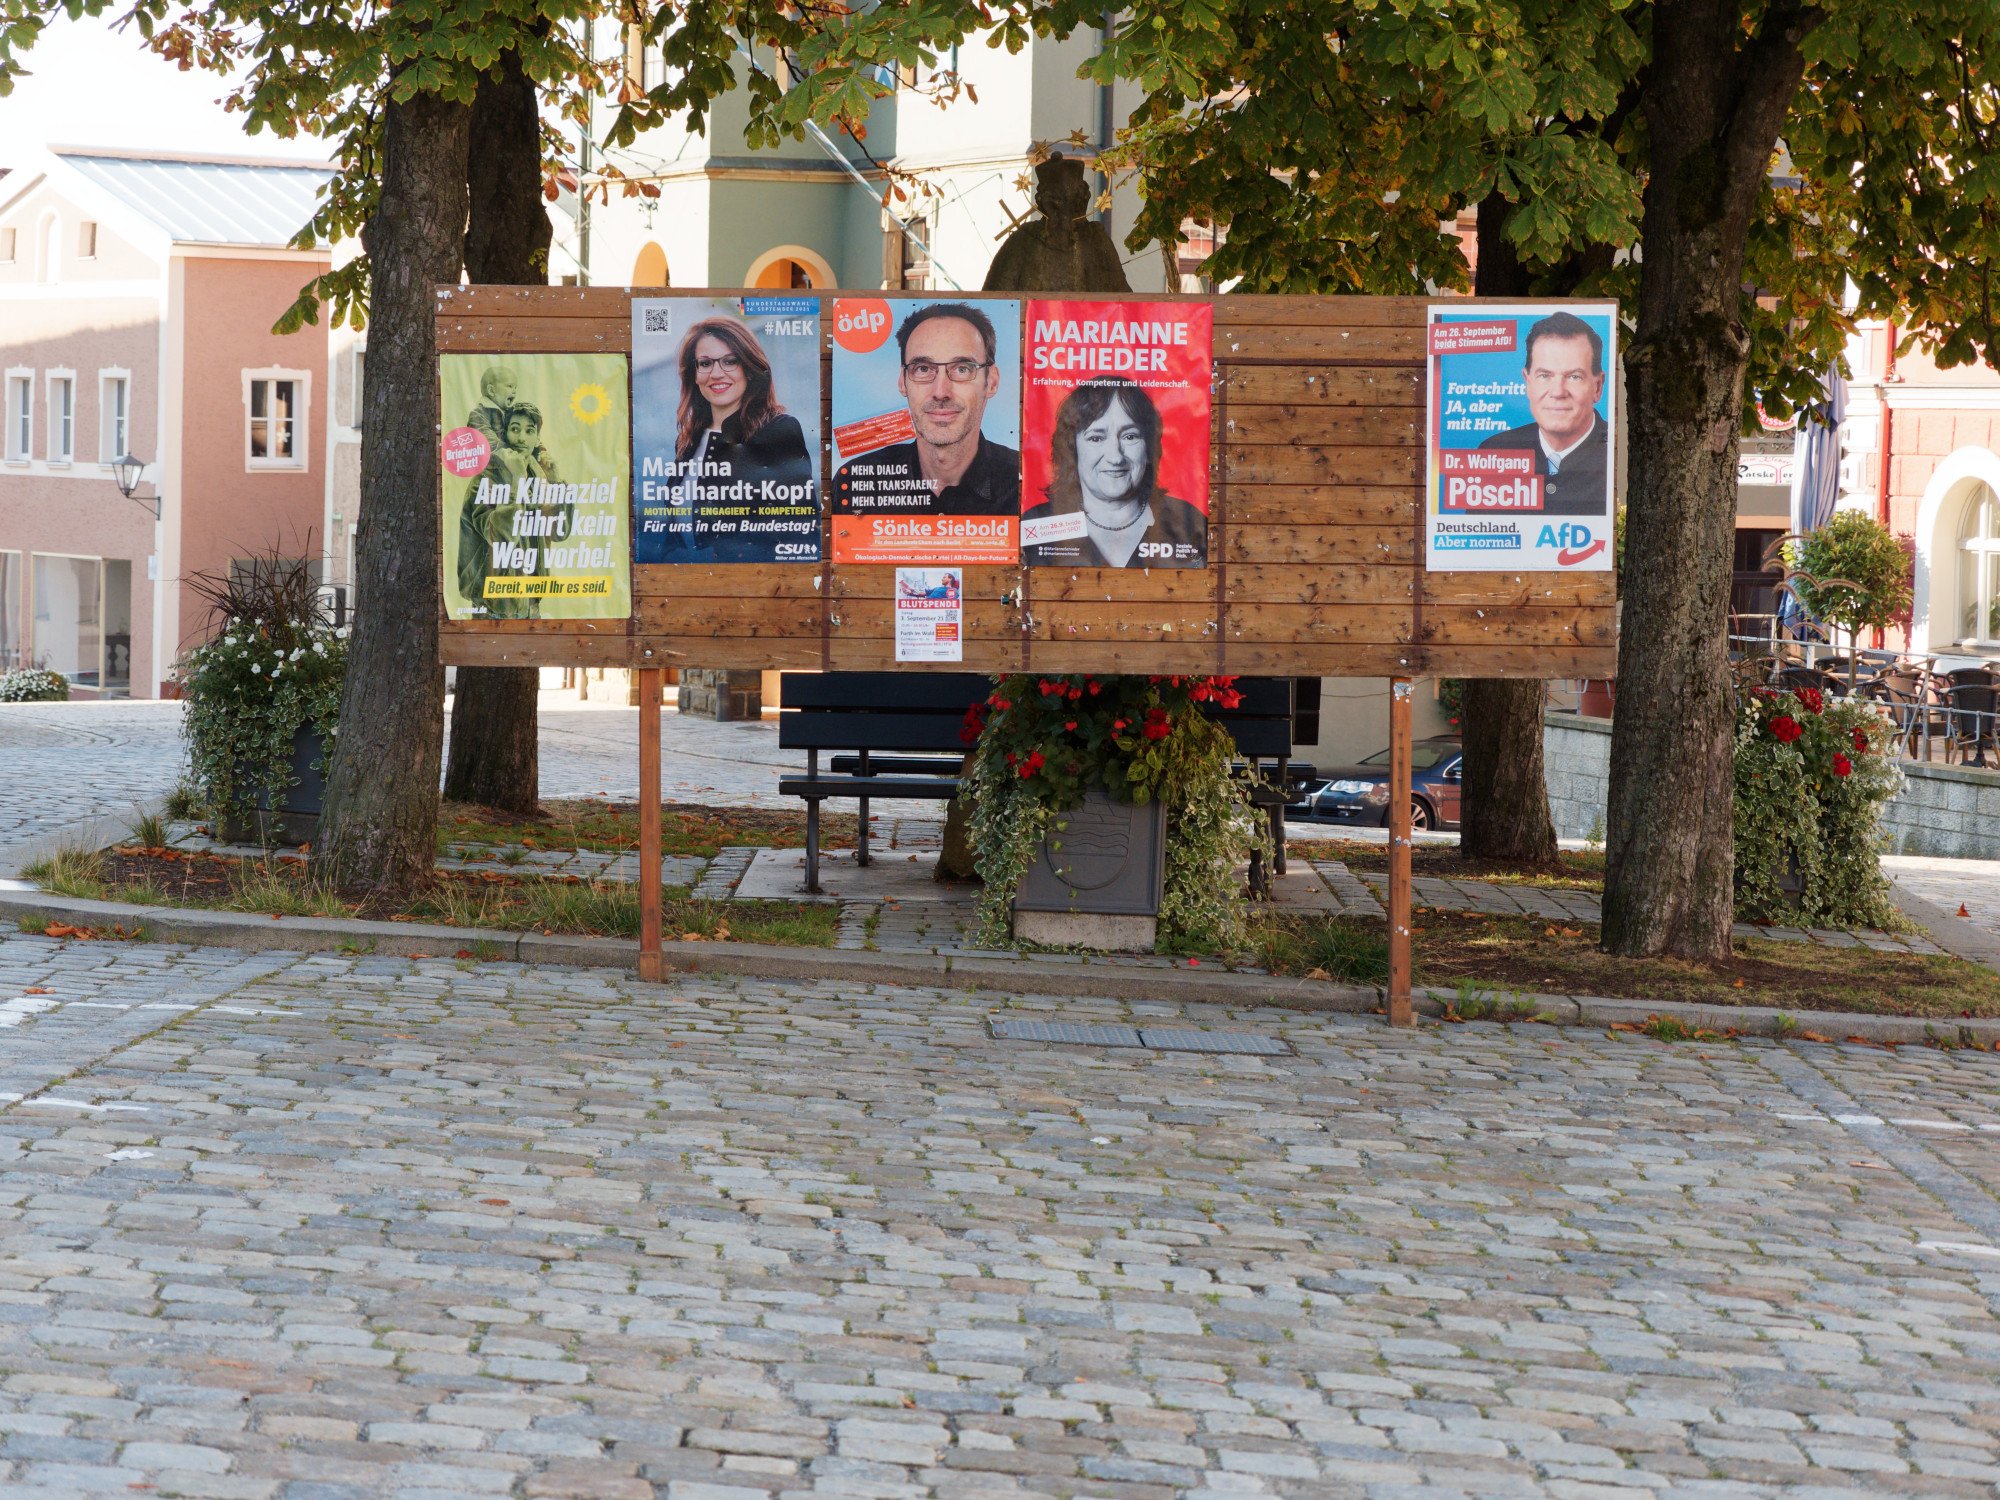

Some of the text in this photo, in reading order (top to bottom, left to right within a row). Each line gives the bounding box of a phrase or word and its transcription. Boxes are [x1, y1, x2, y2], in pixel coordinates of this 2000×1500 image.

[764, 320, 814, 336] #MEK
[838, 308, 885, 333] ödp
[1034, 320, 1188, 345] MARIANNE
[1434, 326, 1507, 337] Am 26. September
[1435, 336, 1512, 349] beide Stimmen AfD!
[1034, 346, 1168, 371] SCHIEDER
[1033, 378, 1074, 388] Erfahrung,
[1076, 379, 1120, 388] Kompetenz
[1139, 380, 1190, 388] Leidenschaft.
[1447, 382, 1527, 395] Fortschritt
[1445, 399, 1503, 415] JA, aber
[1447, 416, 1511, 431] mit Hirn.
[446, 444, 485, 460] Briefwahl
[456, 456, 479, 472] jetzt!
[642, 456, 732, 477] Martina
[851, 464, 908, 476] MEHR DIALOG
[1445, 453, 1530, 472] Dr. Wolfgang
[474, 476, 618, 504] Am Klimaziel
[642, 480, 814, 505] Englhardt-Kopf
[851, 479, 938, 492] MEHR TRANSPARENZ
[1449, 476, 1538, 507] Pöschl
[851, 495, 931, 507] MEHR DEMOKRATIE
[644, 507, 692, 515] MOTIVIERT
[701, 507, 750, 515] ENGAGIERT
[758, 507, 816, 515] KOMPETENT:
[511, 508, 617, 537] führt kein
[643, 520, 816, 534] Für uns in den Bundestag!
[872, 519, 1009, 537] Sönke Siebold
[1436, 522, 1520, 533] Deutschland.
[1435, 536, 1520, 548] Aber normal.
[1535, 522, 1592, 548] AfD
[775, 543, 804, 554] CSU
[1138, 543, 1173, 558] SPD
[492, 541, 616, 574] Weg vorbei.
[854, 553, 931, 562] Ökologisch-Demokrtische
[487, 580, 608, 595] Bereit, weil Ihr es seid.
[901, 600, 957, 608] BLUTSPENDE
